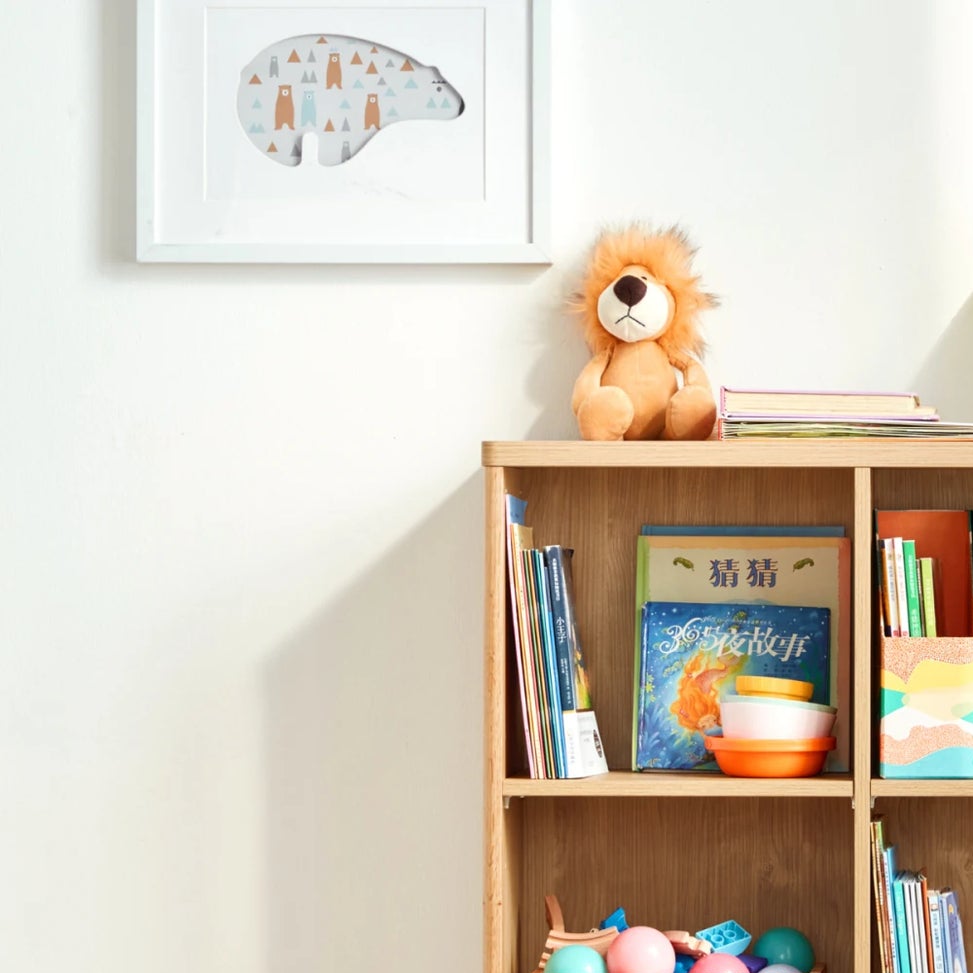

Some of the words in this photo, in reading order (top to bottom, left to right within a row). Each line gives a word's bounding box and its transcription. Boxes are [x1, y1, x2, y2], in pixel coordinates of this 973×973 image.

[709, 558, 779, 588] 猜猜
[555, 616, 567, 643] 小王子
[659, 617, 811, 662] 365夜故事
